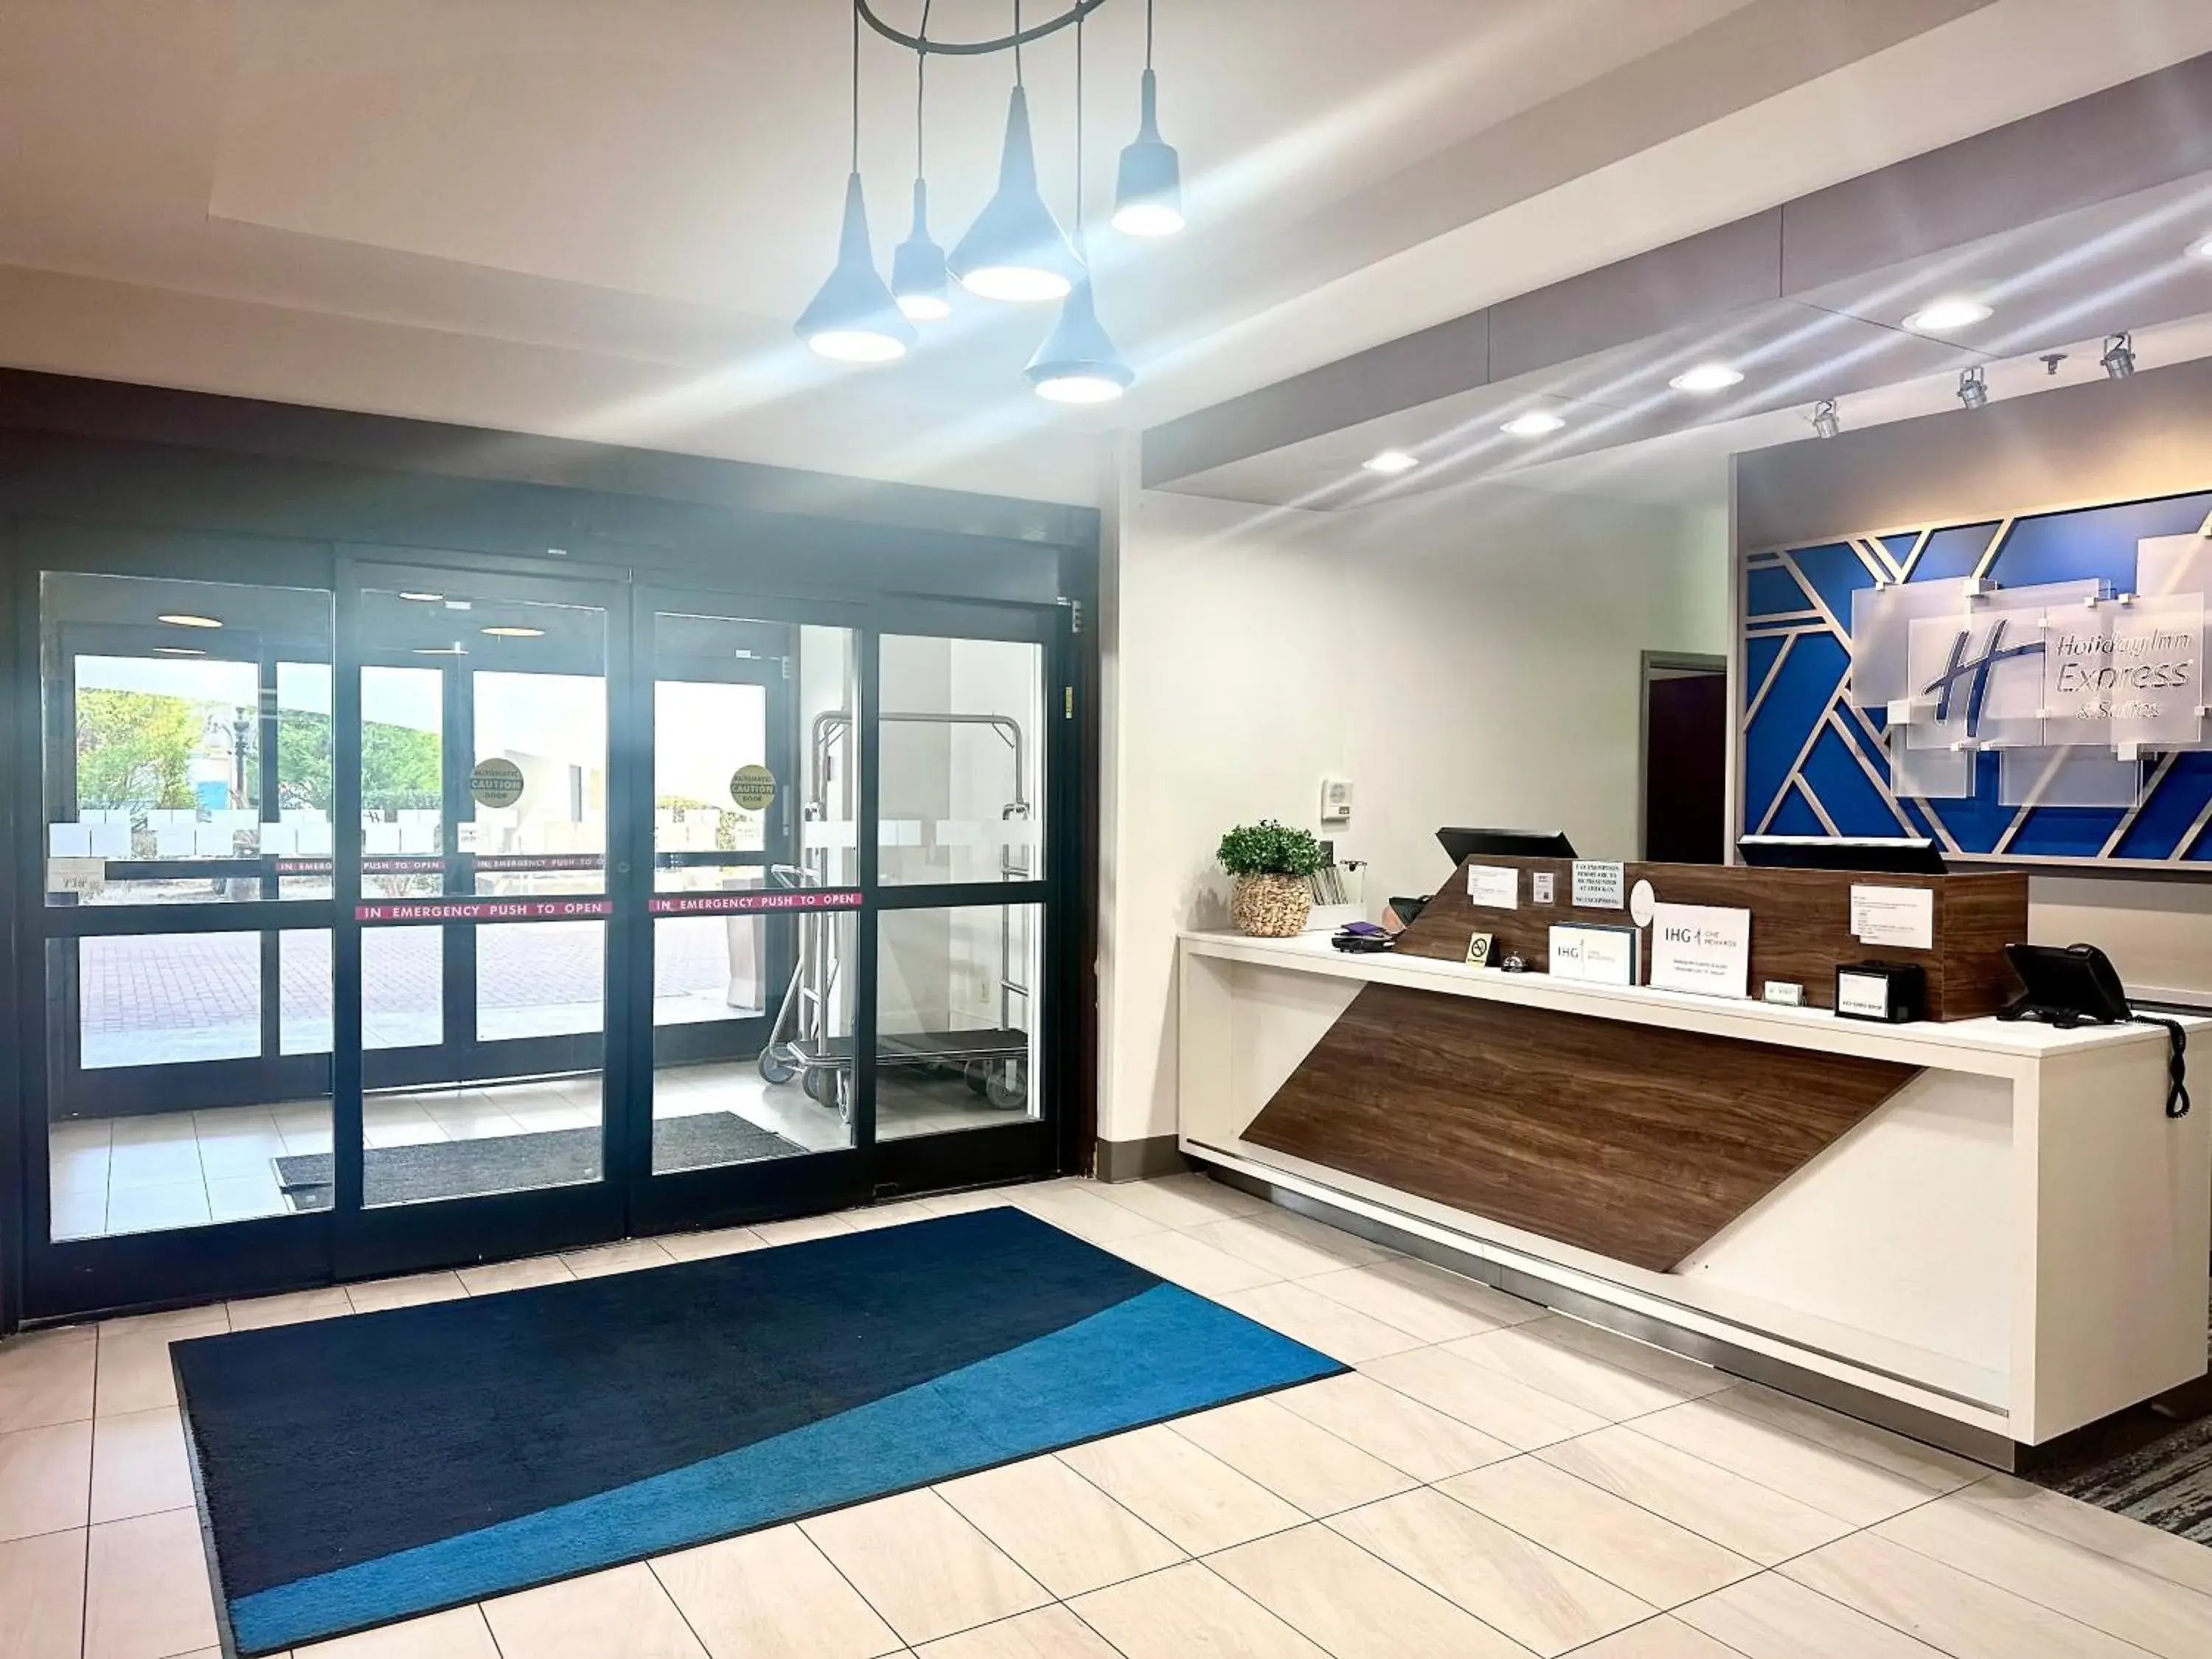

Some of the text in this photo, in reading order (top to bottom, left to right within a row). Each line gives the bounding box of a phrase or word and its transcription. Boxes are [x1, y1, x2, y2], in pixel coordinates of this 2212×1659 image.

[2057, 628, 2191, 657] Holiday Inn
[2056, 662, 2189, 695] Express
[471, 779, 521, 790] CAUTION
[732, 784, 773, 794] CAUTION
[364, 861, 389, 869] PUSH
[656, 894, 855, 911] IN EMERGENCY PUSH TO OPEN
[365, 903, 602, 919] IN EMERGENCY PUSH TO OPEN
[1666, 927, 1691, 943] IHG
[1558, 945, 1579, 958] IHG
